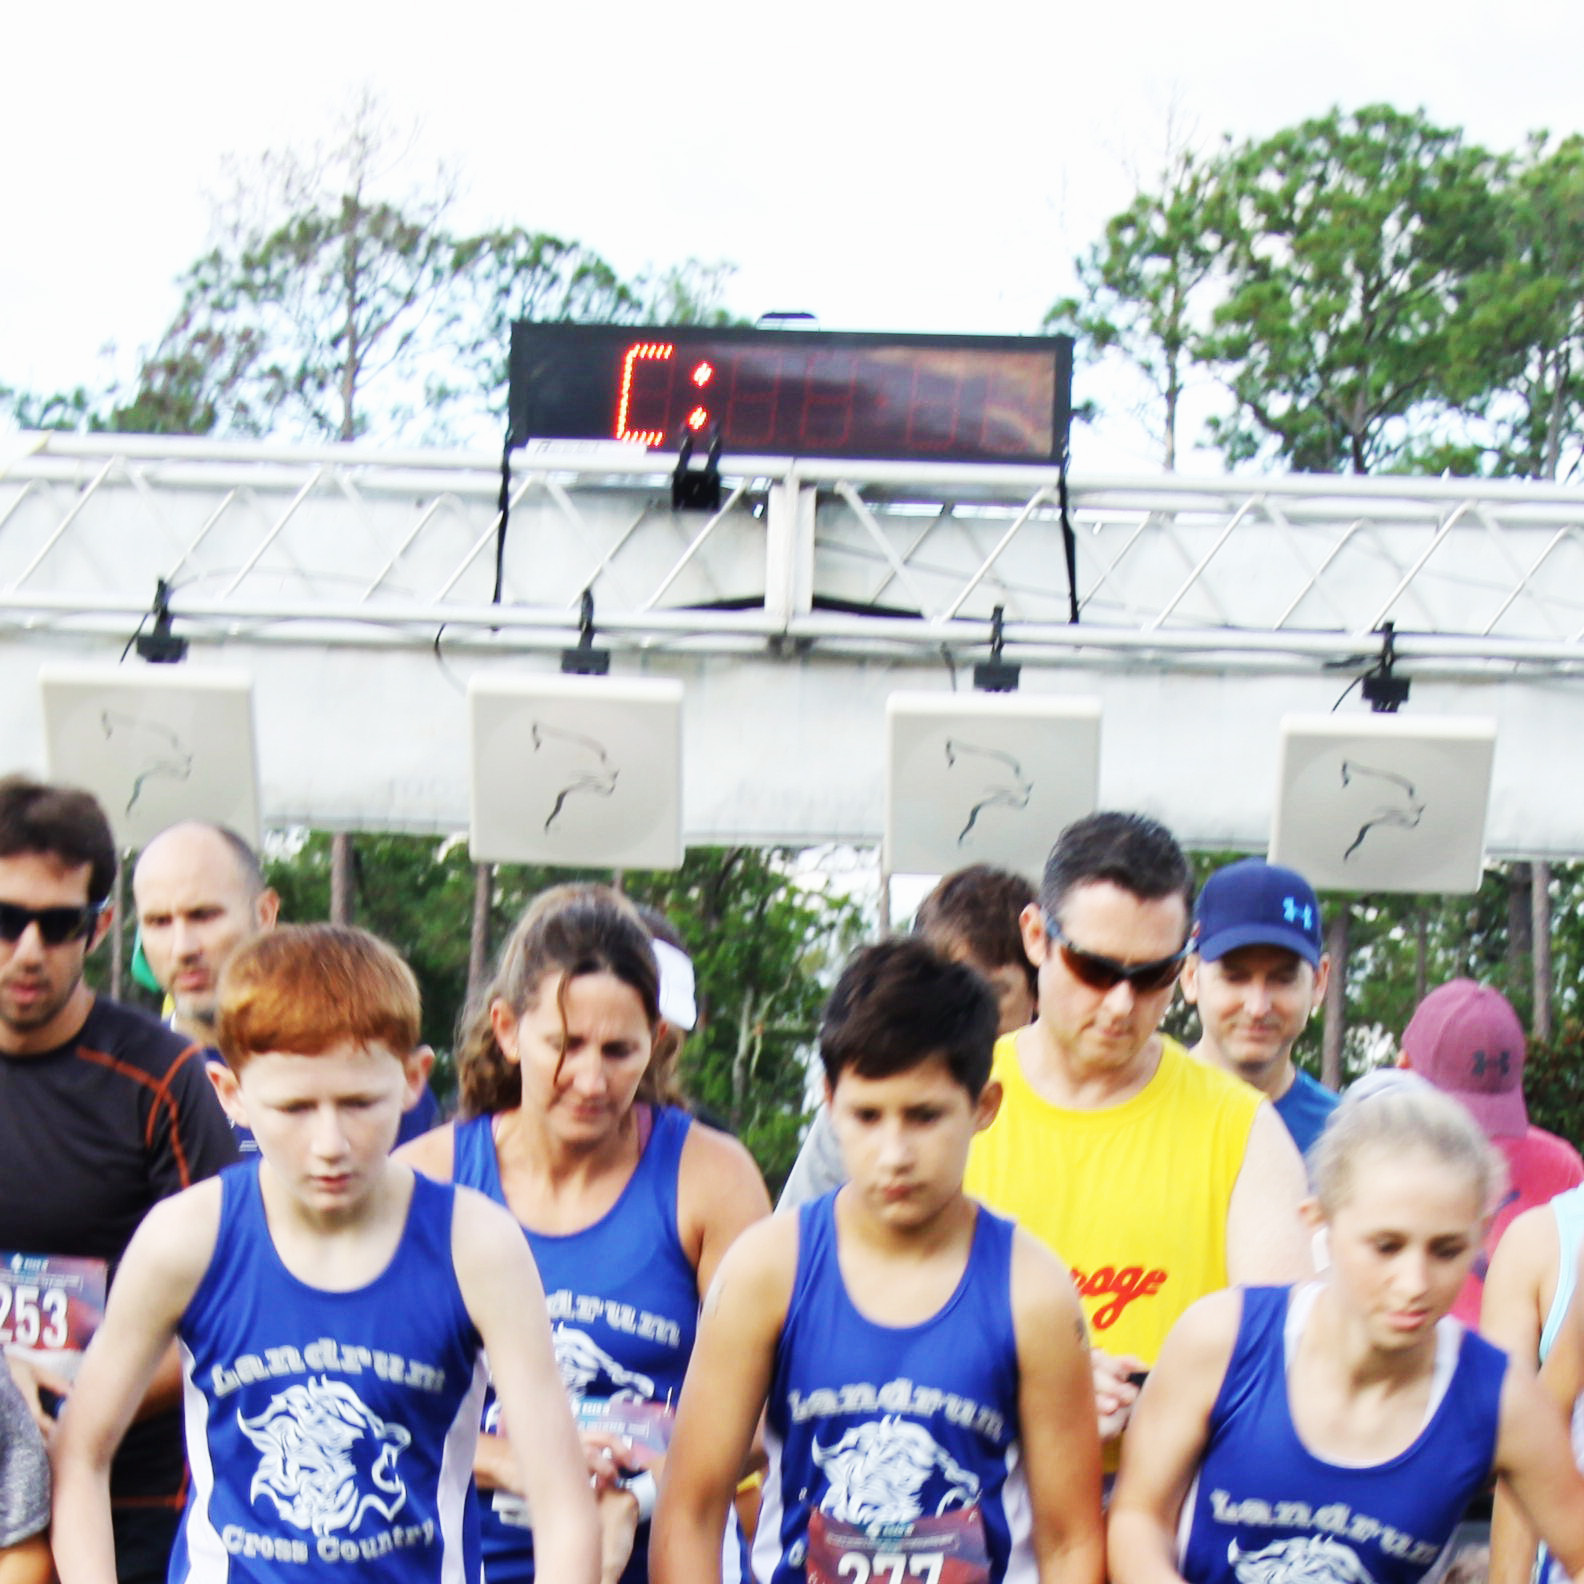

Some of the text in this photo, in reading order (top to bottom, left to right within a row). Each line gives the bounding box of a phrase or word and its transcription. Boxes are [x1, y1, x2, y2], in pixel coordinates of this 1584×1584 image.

[211, 1337, 446, 1399] Landrum
[787, 1377, 1005, 1444] Landrum
[222, 1517, 435, 1566] Cross Country
